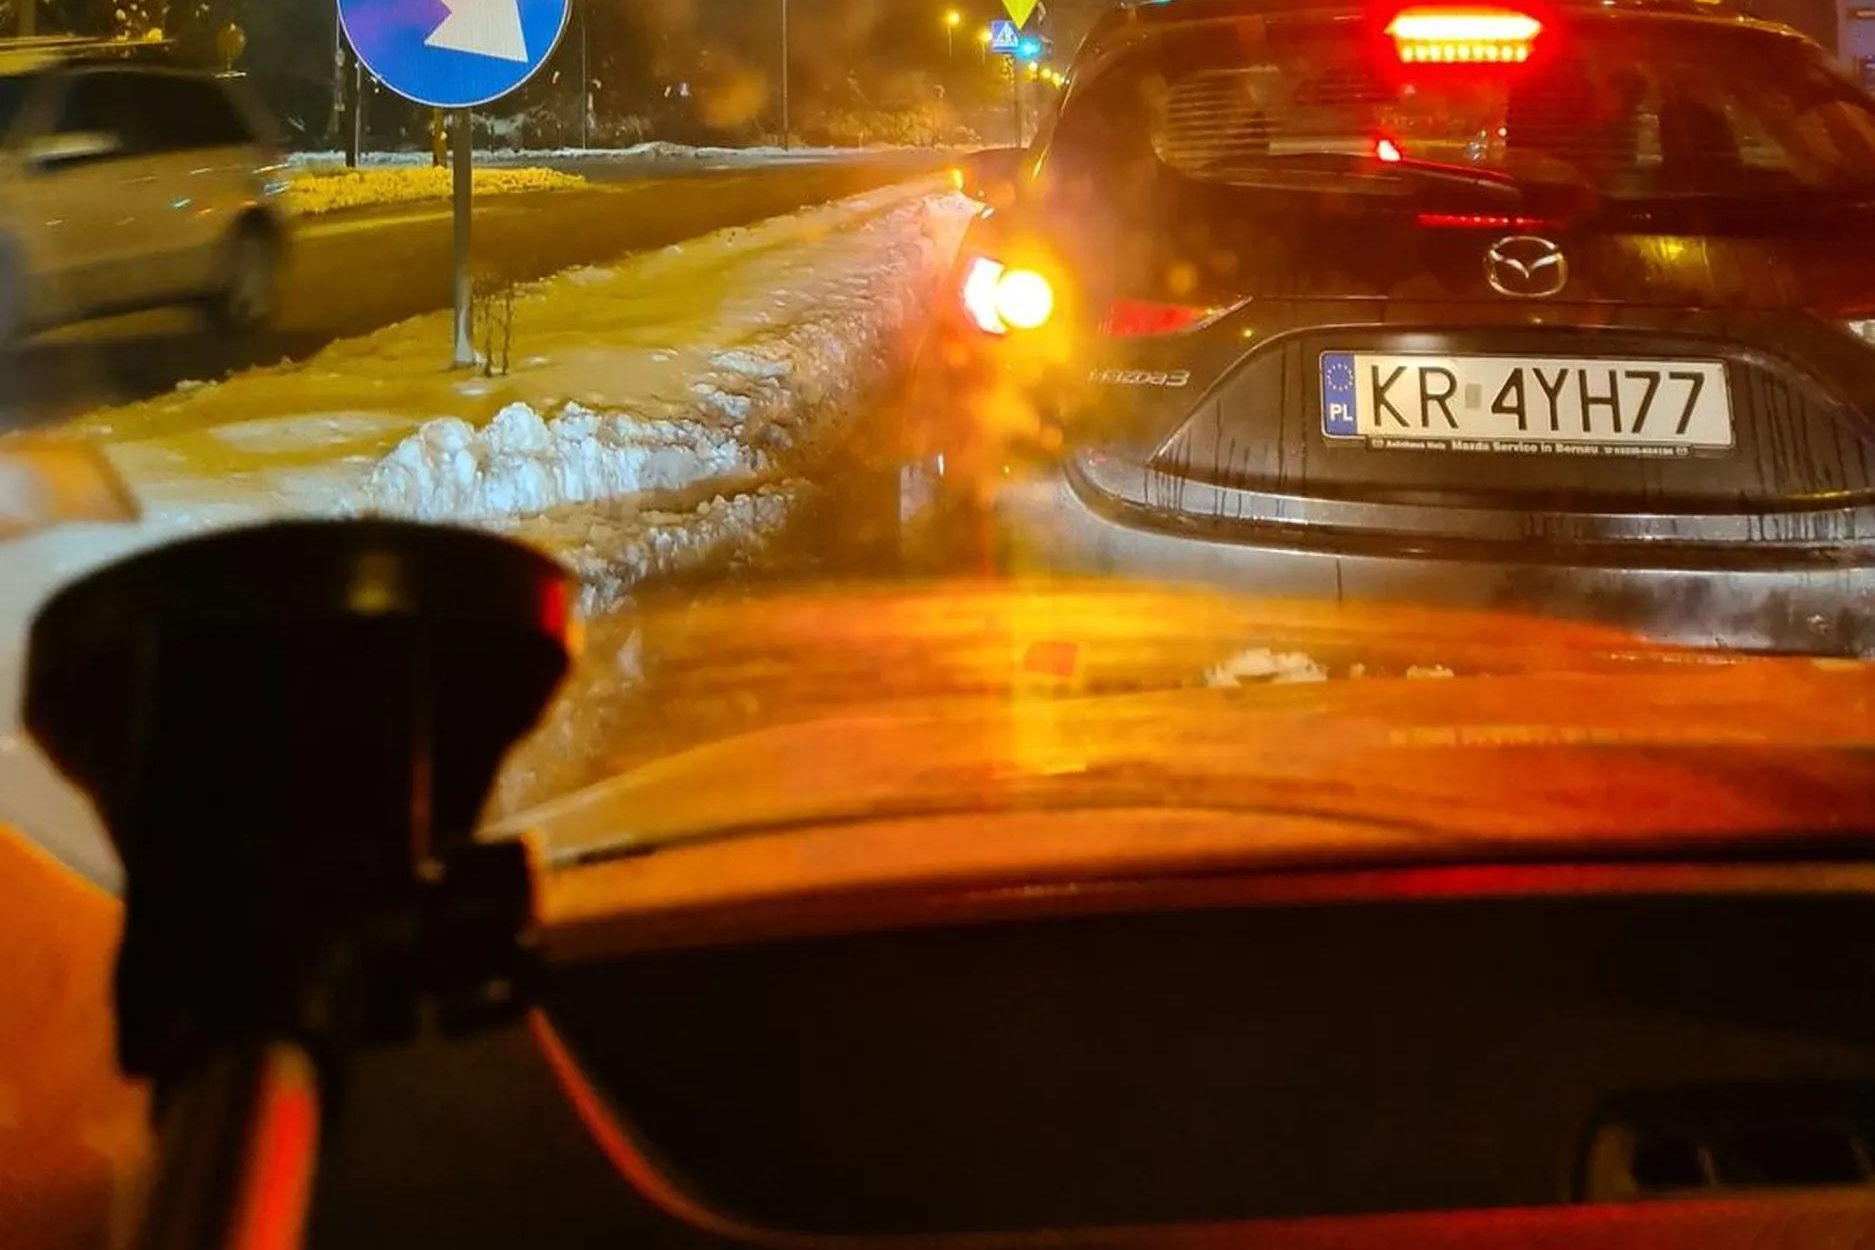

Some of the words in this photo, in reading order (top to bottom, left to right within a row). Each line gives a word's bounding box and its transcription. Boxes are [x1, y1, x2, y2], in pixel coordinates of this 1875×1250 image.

[1370, 364, 1460, 429] KR
[1490, 367, 1705, 435] 4YH77
[1330, 403, 1354, 421] PL
[1451, 440, 1490, 451] Mazda
[1493, 441, 1538, 453] Service
[1541, 442, 1553, 453] in
